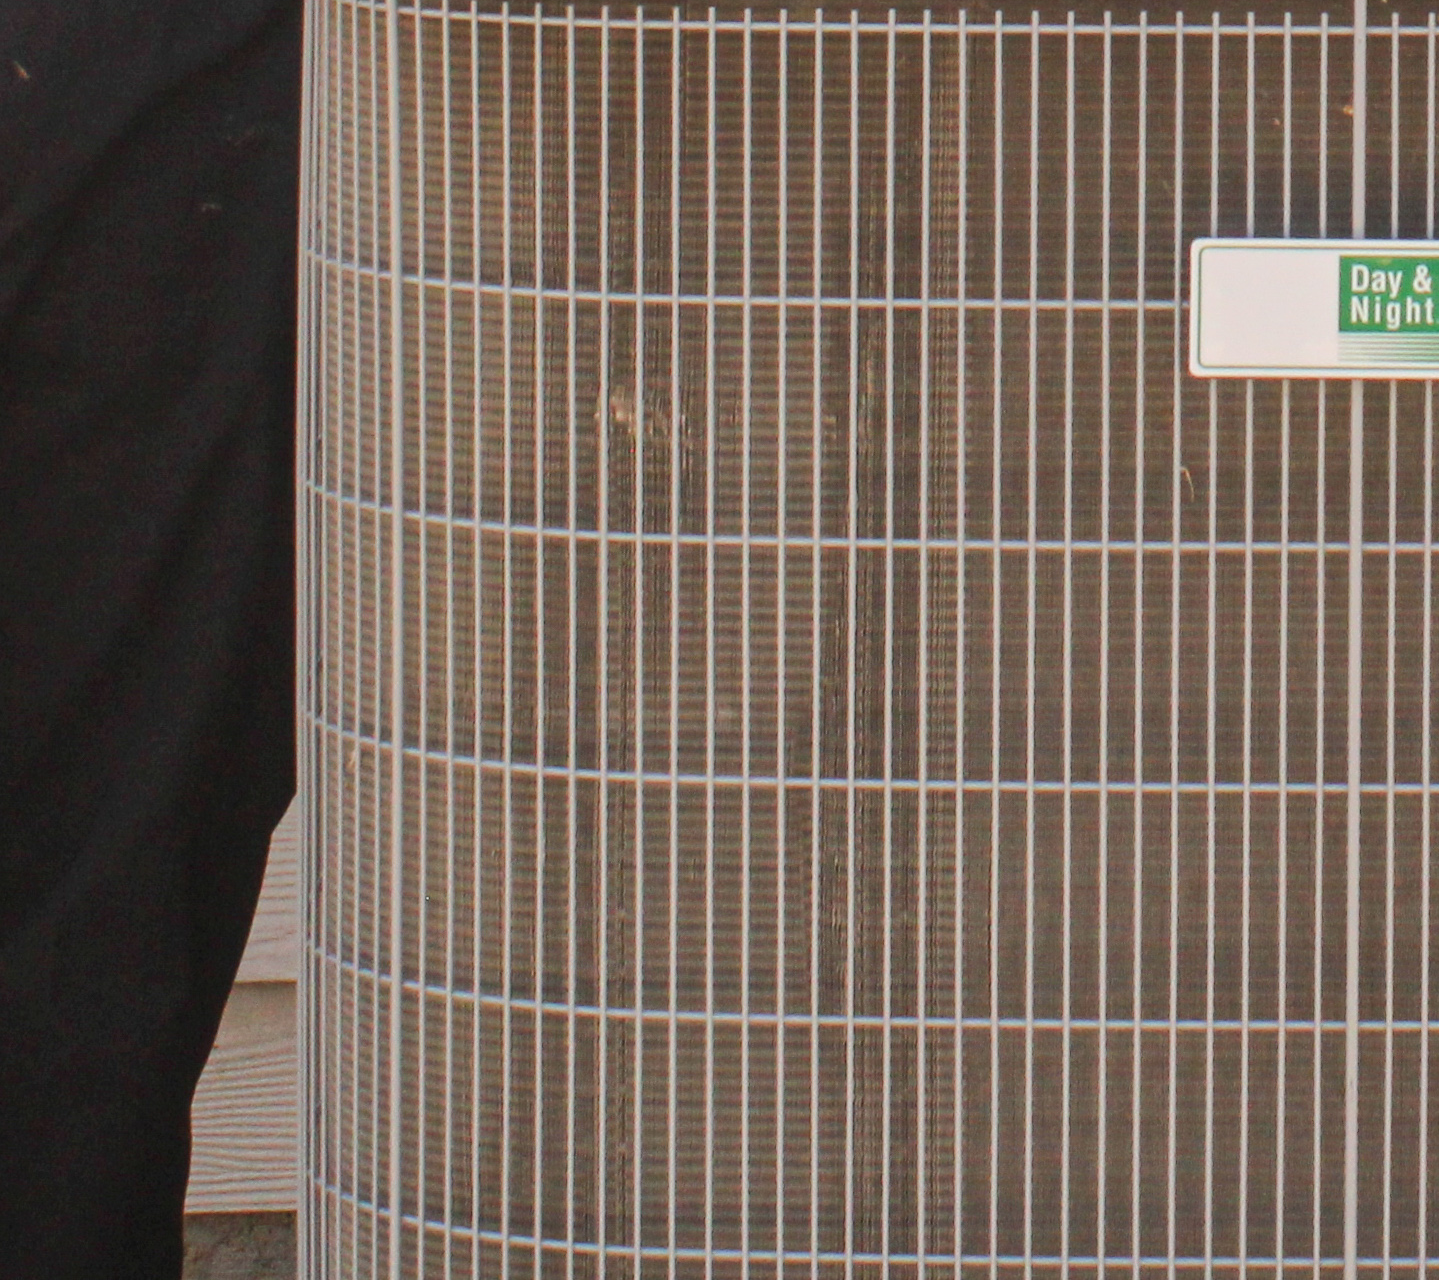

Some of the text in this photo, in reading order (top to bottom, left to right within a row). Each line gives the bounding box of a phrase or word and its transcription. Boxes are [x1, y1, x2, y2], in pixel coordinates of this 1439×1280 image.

[1350, 263, 1432, 299] Day &
[1350, 295, 1434, 331] Night
